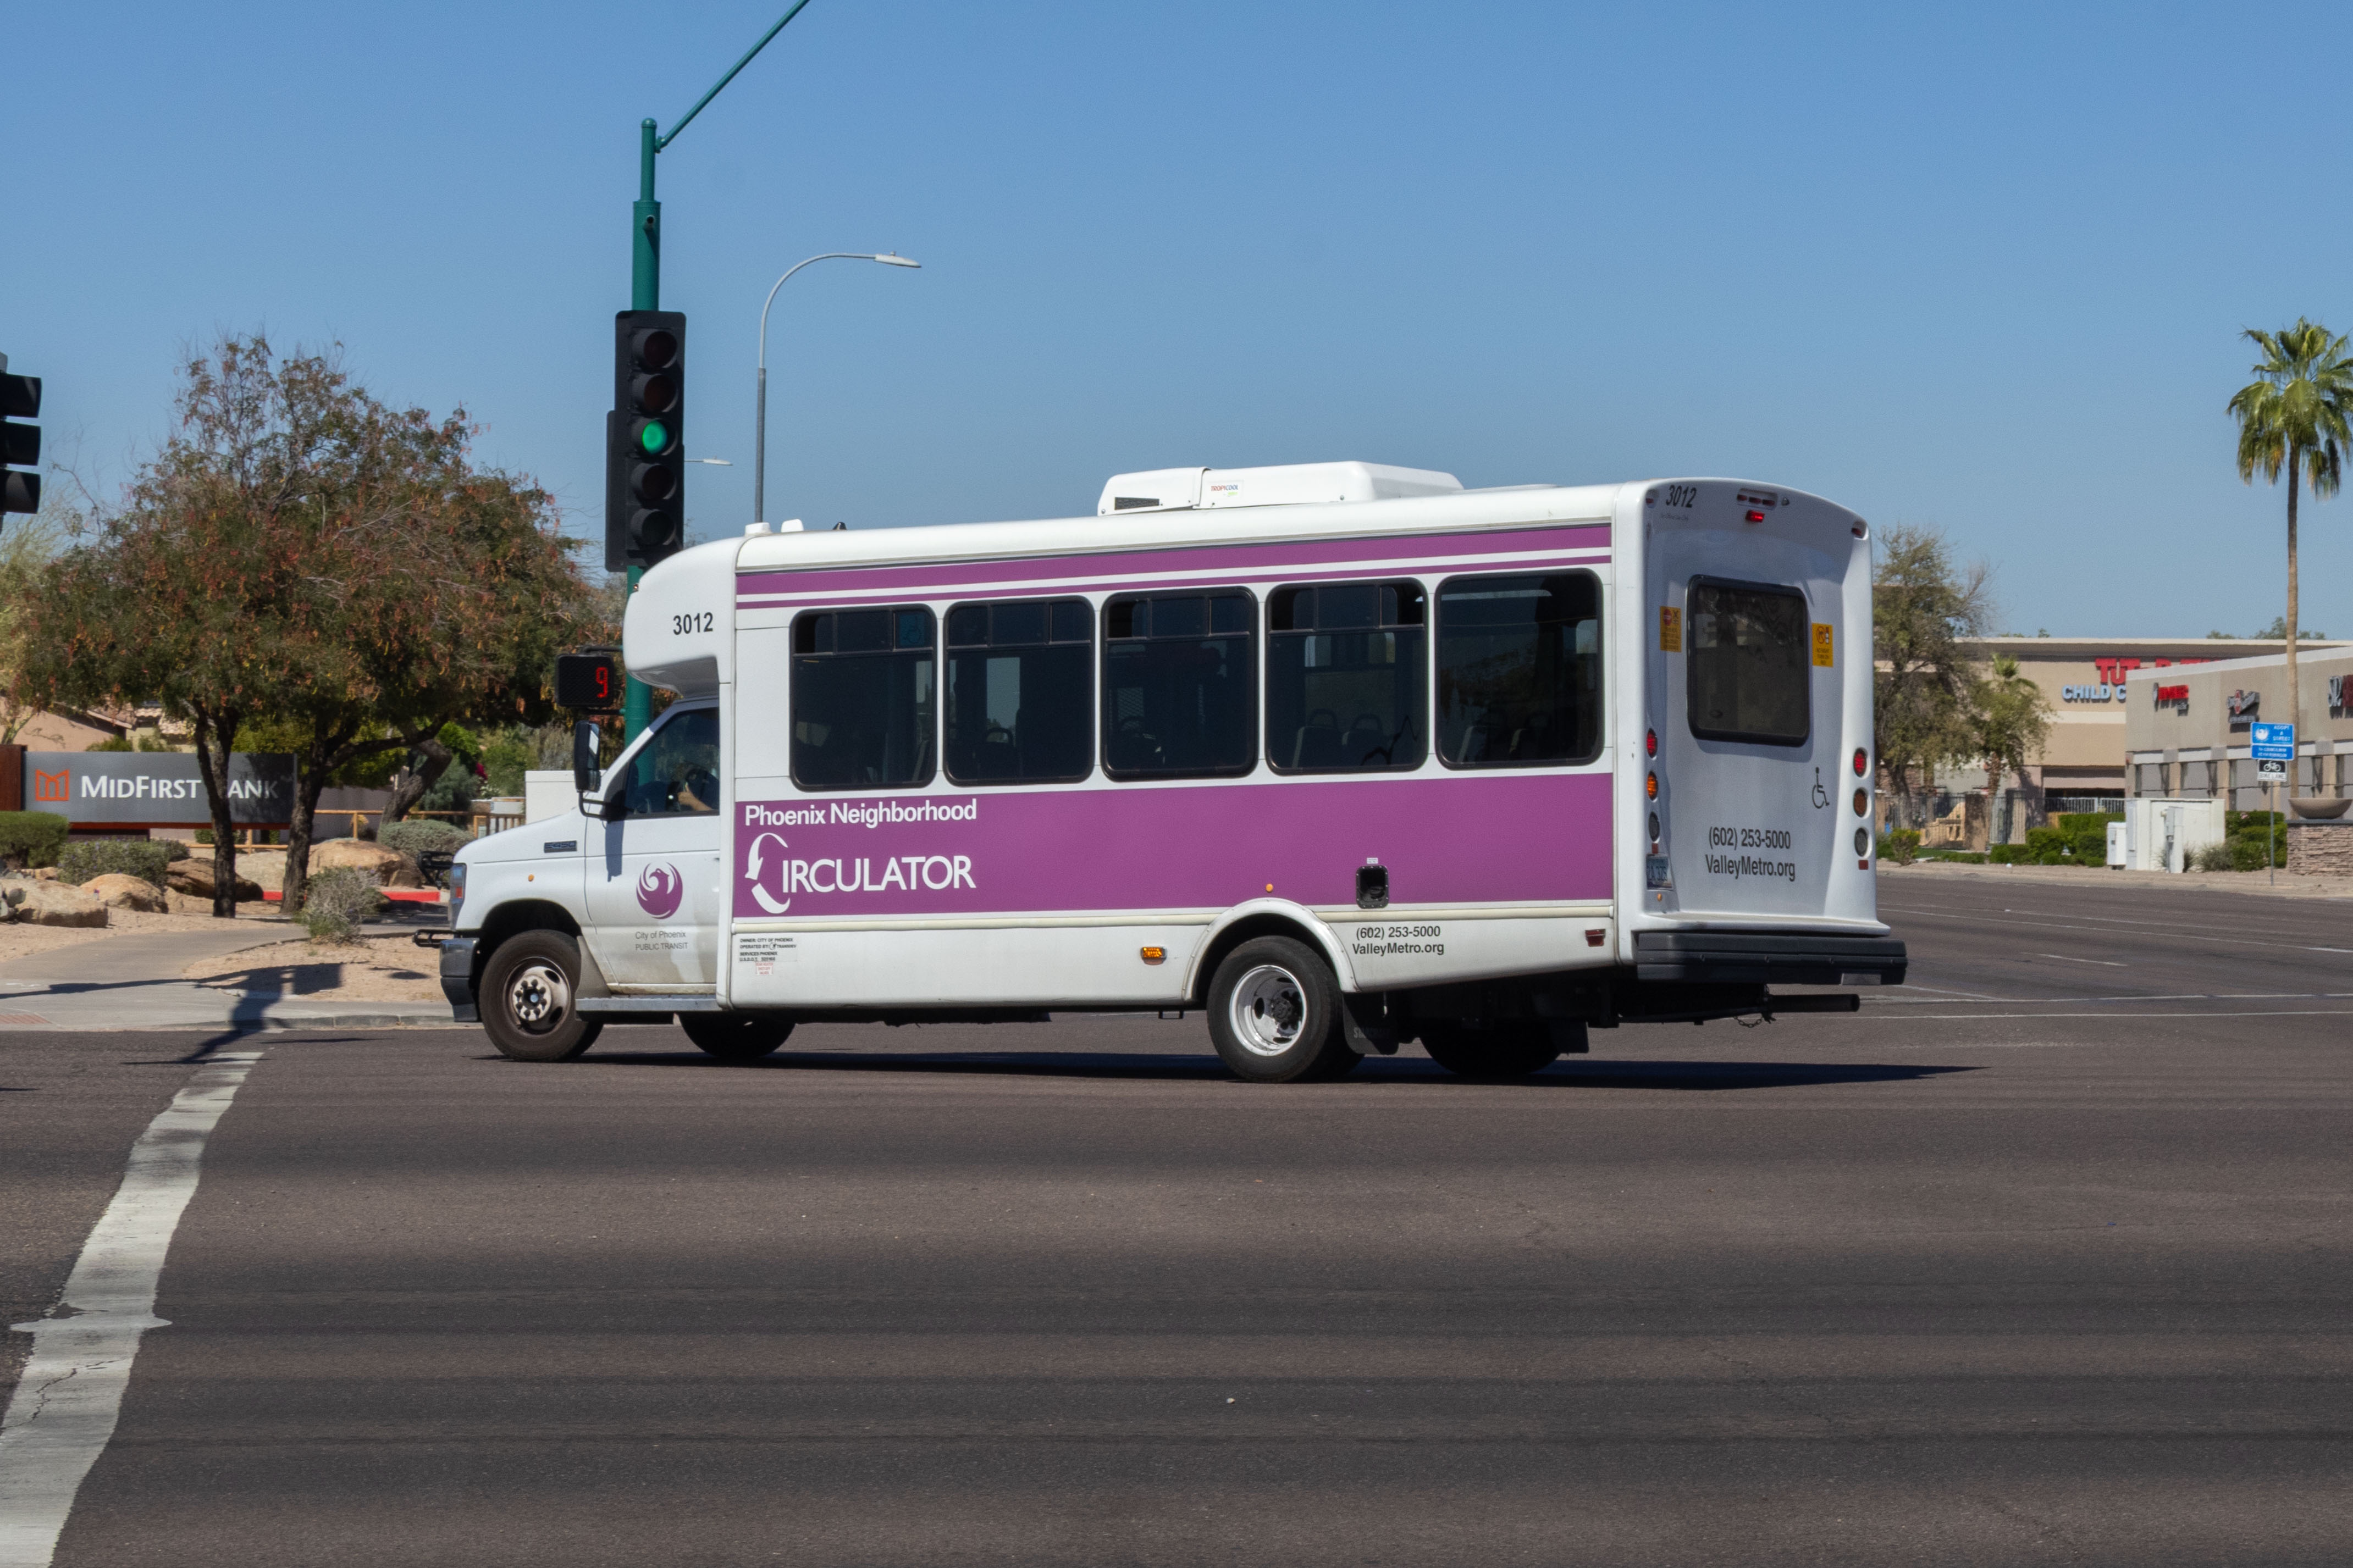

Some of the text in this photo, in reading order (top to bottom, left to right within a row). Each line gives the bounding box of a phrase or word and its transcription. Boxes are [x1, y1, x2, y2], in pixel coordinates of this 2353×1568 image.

[1666, 485, 1697, 508] 3012
[673, 612, 713, 635] 3012
[596, 667, 609, 698] 9
[2062, 685, 2111, 700] CHILD
[227, 779, 278, 799] ANK
[745, 799, 977, 829] Phoenix Neighborhood
[1709, 827, 1791, 851] (602) 253-5000
[1705, 854, 1796, 882] ValleyMetro.org
[636, 931, 648, 940] City
[1356, 926, 1440, 940] (602) 253-5000
[1352, 943, 1444, 957] ValleyMetro.org
